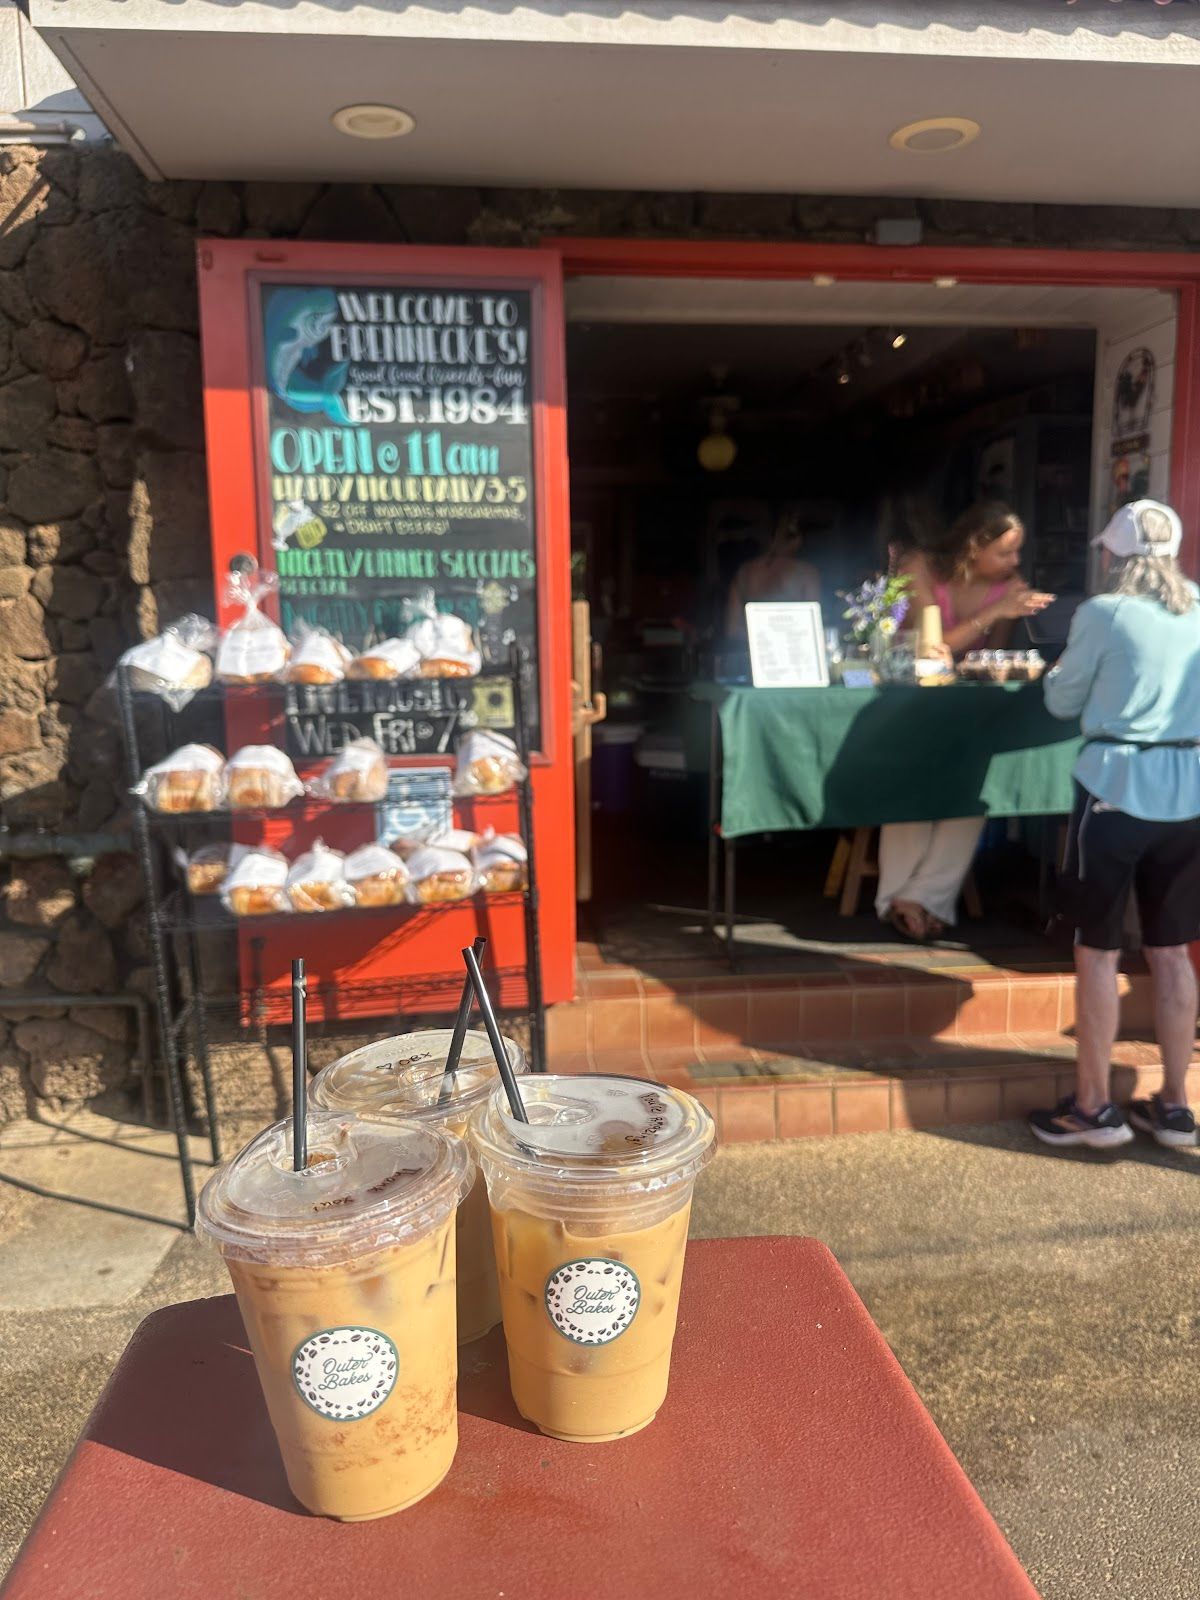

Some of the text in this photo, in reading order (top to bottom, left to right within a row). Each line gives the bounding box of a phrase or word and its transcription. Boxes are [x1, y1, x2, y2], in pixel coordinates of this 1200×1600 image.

[337, 292, 518, 327] WELCOME TO
[271, 426, 374, 474] OPEN
[272, 474, 353, 502] HAPPY
[574, 1285, 620, 1301] Outer
[565, 1299, 617, 1315] Bakes
[322, 1351, 374, 1375] Outer
[317, 1371, 373, 1391] Bakes
